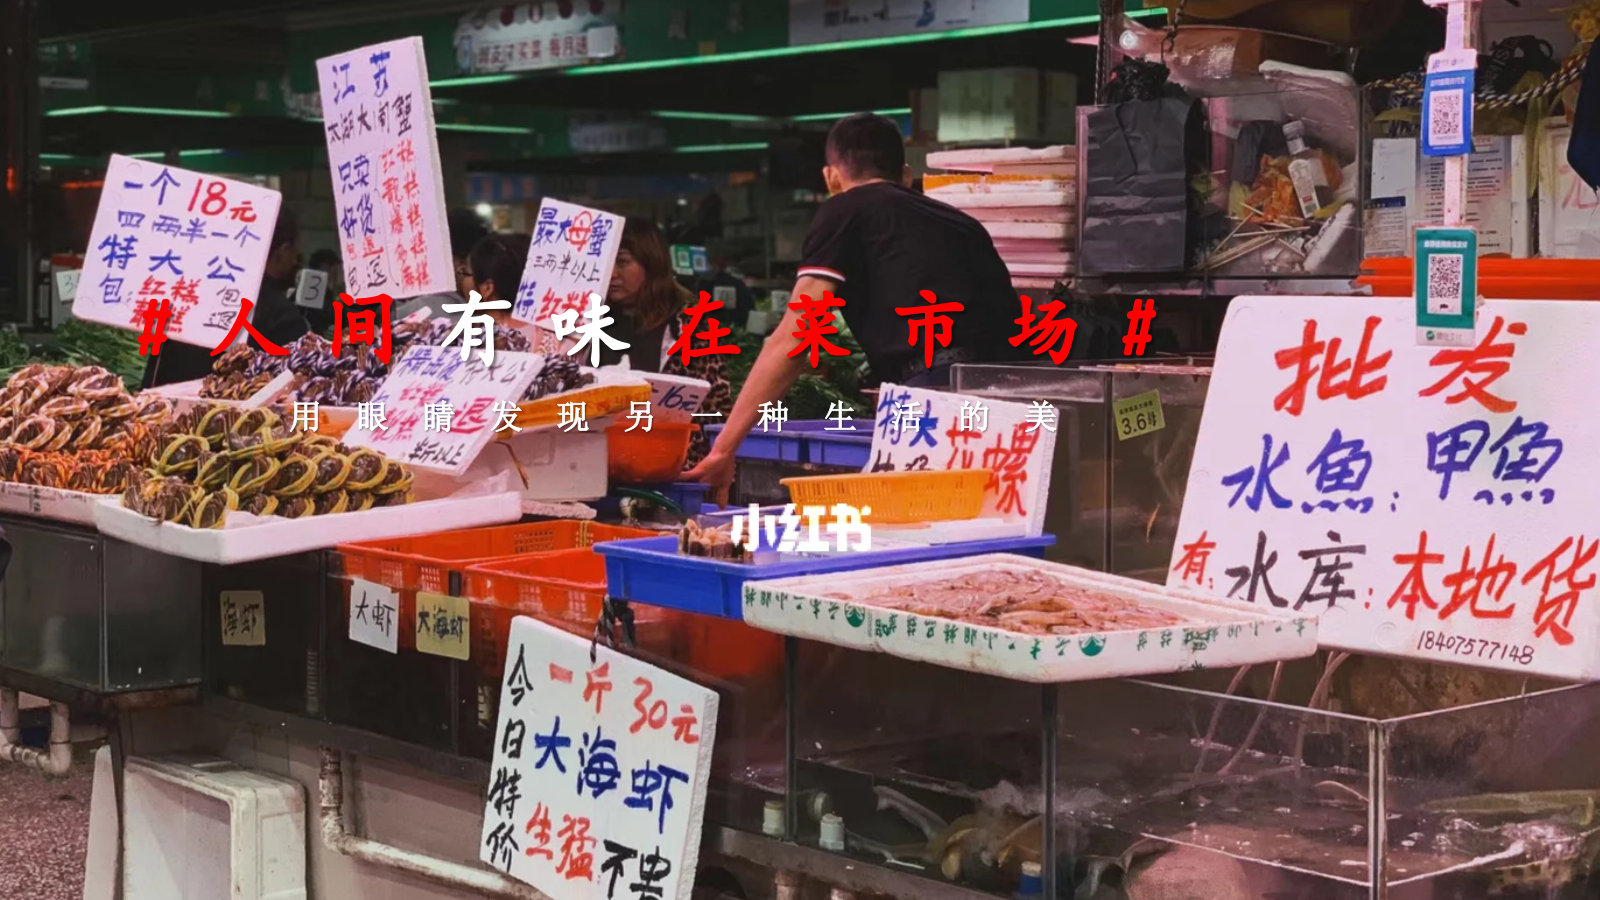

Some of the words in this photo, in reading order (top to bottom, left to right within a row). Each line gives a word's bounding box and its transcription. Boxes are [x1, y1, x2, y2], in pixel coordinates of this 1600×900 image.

[332, 50, 391, 105] 江苏
[337, 154, 371, 195] 只卖
[117, 209, 262, 249] 四两半一个
[532, 206, 613, 258] 最大母蟹
[97, 234, 246, 283] 特大公
[533, 249, 601, 284] 三两半以上
[304, 275, 323, 300] 3
[1274, 315, 1529, 417] 批发
[354, 589, 397, 637] 大虾
[1386, 530, 1600, 648] 本地货
[222, 596, 260, 637] 海虾
[416, 603, 469, 644] 大海虾
[1416, 629, 1536, 666] 18407577148
[548, 661, 700, 744] 一斤30元
[486, 643, 535, 873] 今日特价
[533, 715, 690, 835] 大海虾
